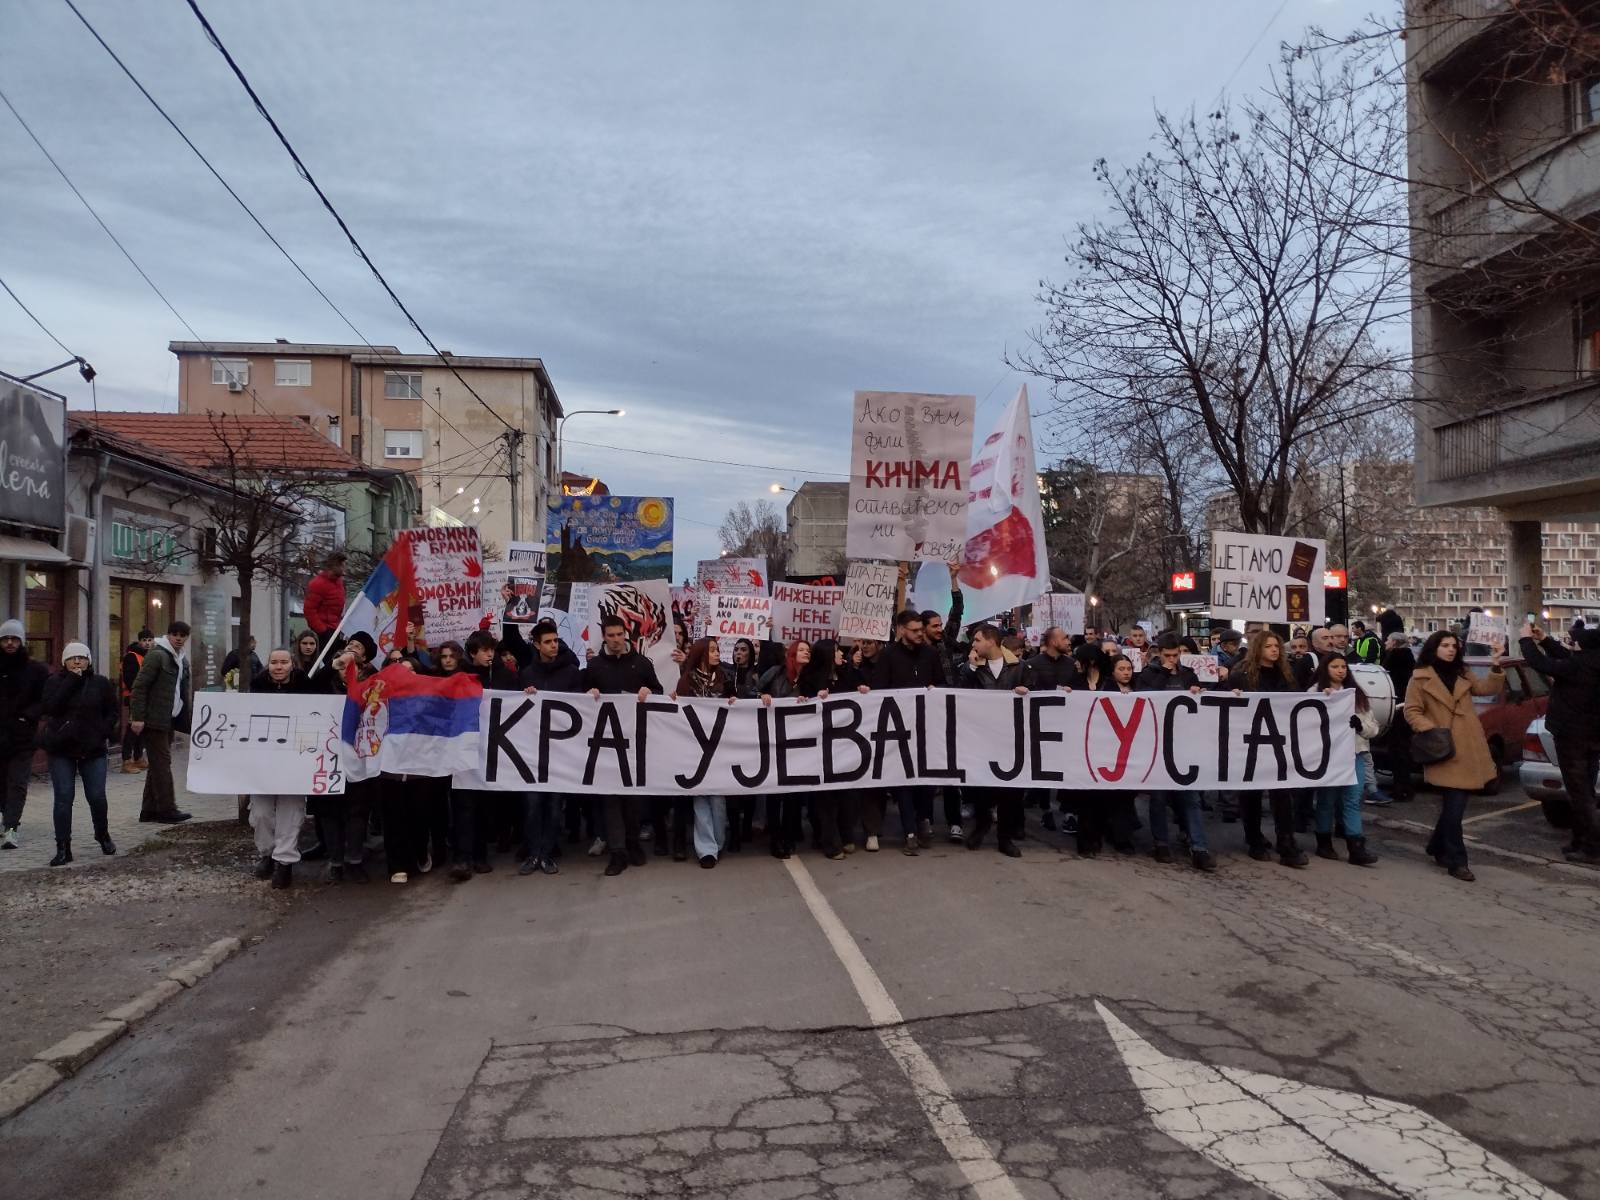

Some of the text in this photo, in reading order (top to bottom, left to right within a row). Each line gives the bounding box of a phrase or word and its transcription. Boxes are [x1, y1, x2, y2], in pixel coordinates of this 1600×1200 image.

[0, 439, 51, 499] lena
[865, 459, 961, 490] КИЧМА
[429, 540, 478, 555] БРАНИ
[1213, 544, 1283, 574] ШЕТАМО
[718, 596, 769, 610] БЛОКАДА
[866, 583, 897, 600] СТАН
[1213, 581, 1282, 611] ШЕТАМО
[744, 612, 754, 620] НЕ
[792, 607, 832, 625] НЕЋЕ
[486, 693, 1331, 789] КРАГУЈЕВАЦ ЈЕ (У)СТАО
